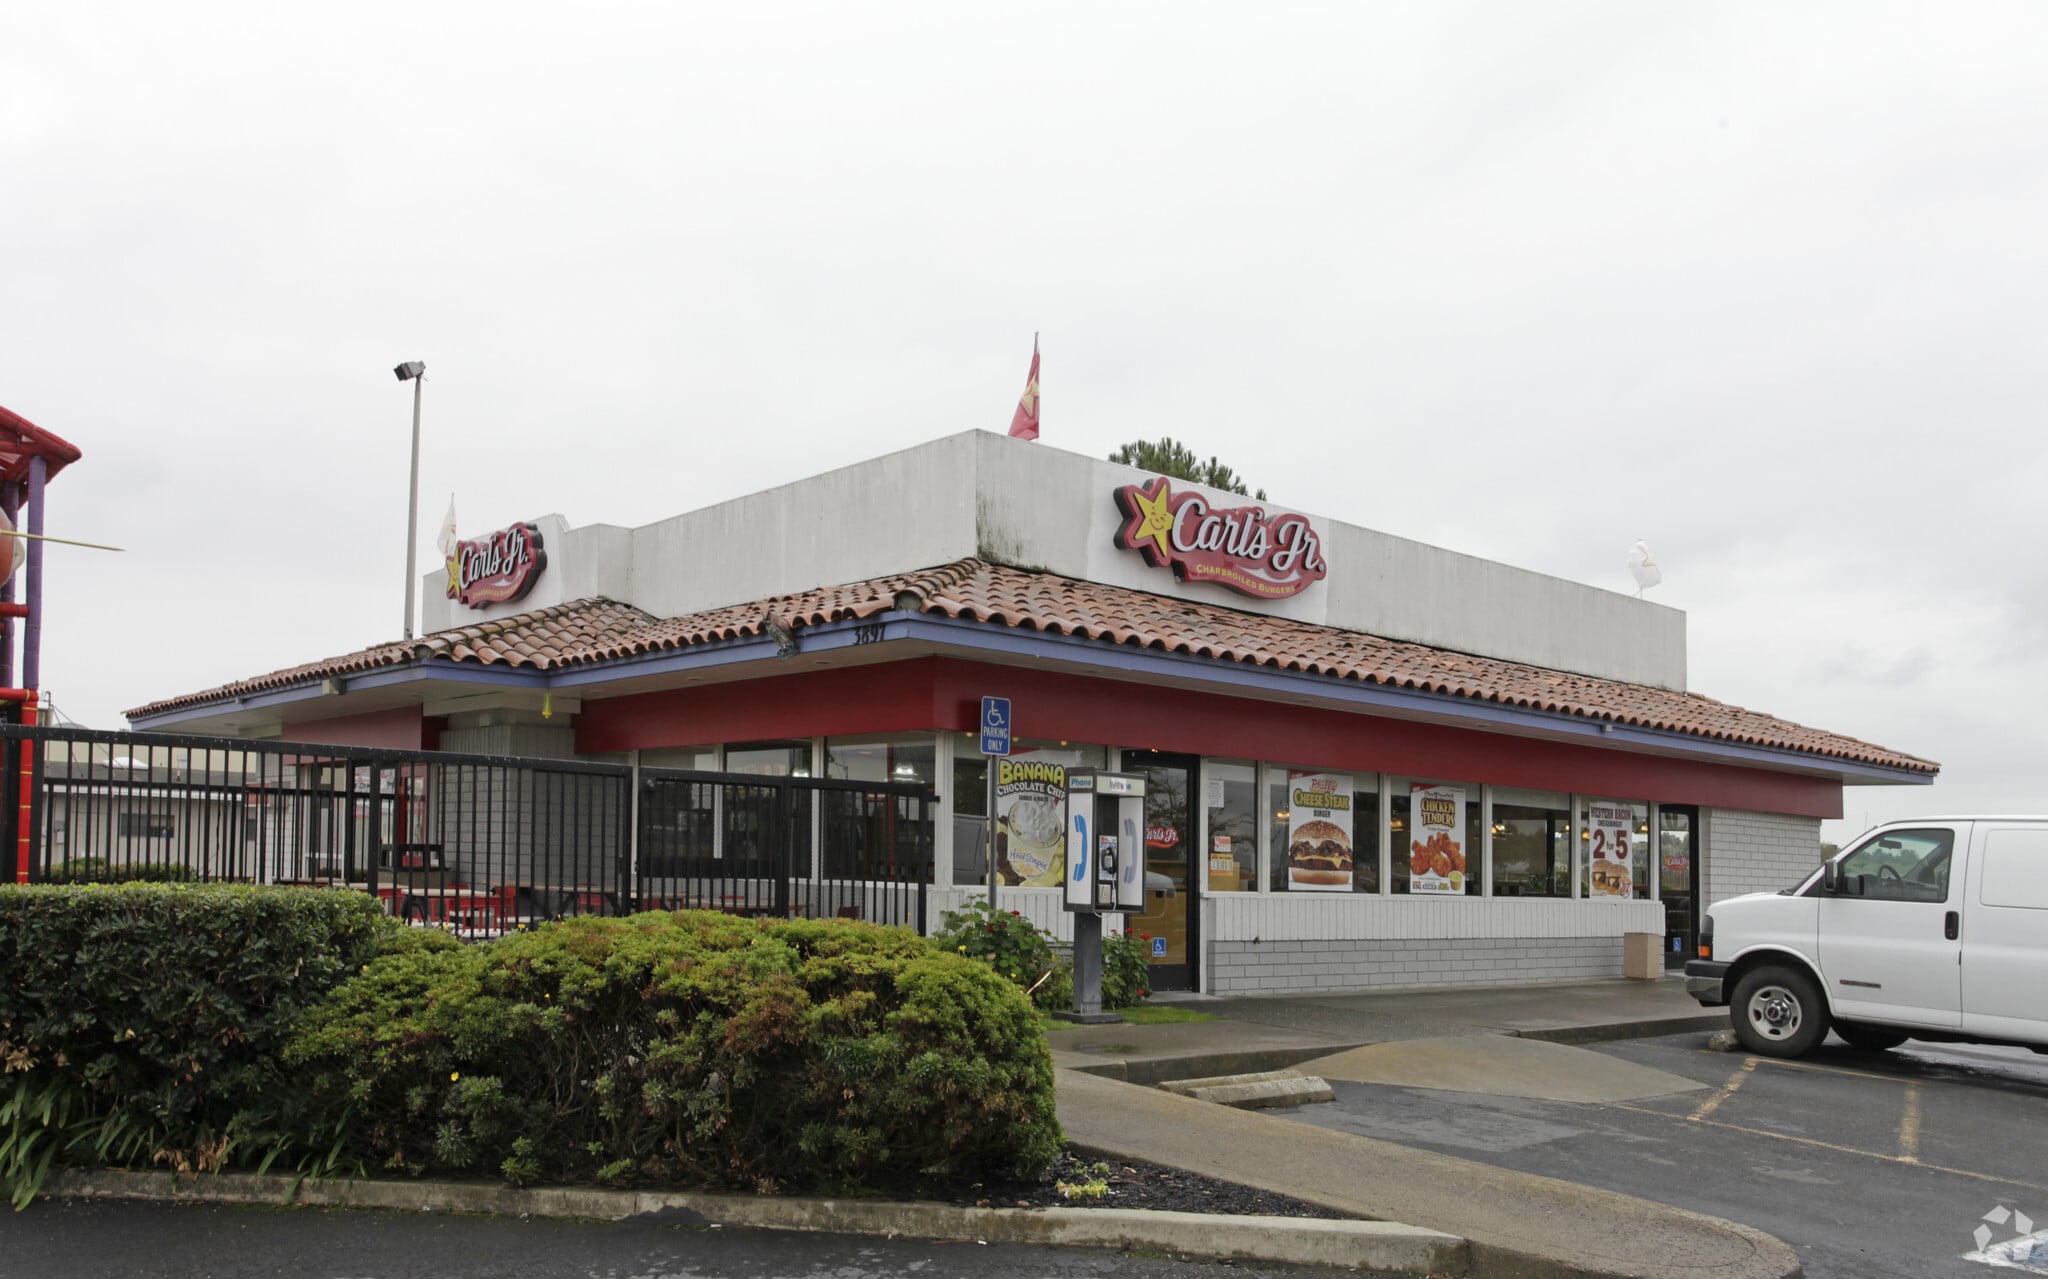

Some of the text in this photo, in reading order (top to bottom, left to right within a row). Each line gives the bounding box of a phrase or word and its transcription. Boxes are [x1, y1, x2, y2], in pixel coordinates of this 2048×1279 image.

[1171, 499, 1325, 572] Carl's Jr.
[460, 527, 529, 589] Carl's Jr.
[1196, 563, 1296, 595] CHARBROILED BURGERS
[852, 622, 887, 646] 3897
[983, 726, 1008, 739] PARKING
[987, 738, 1003, 752] ONLY
[999, 759, 1066, 789] BANANA
[997, 782, 1046, 797] CHOCOLATE
[1311, 778, 1337, 793] Philly
[1313, 810, 1331, 818] BURGER
[1421, 798, 1455, 815] CHICKEN
[1422, 811, 1455, 828] TENDERS
[1146, 826, 1179, 843] arl's Jr.
[1593, 828, 1606, 859] 2
